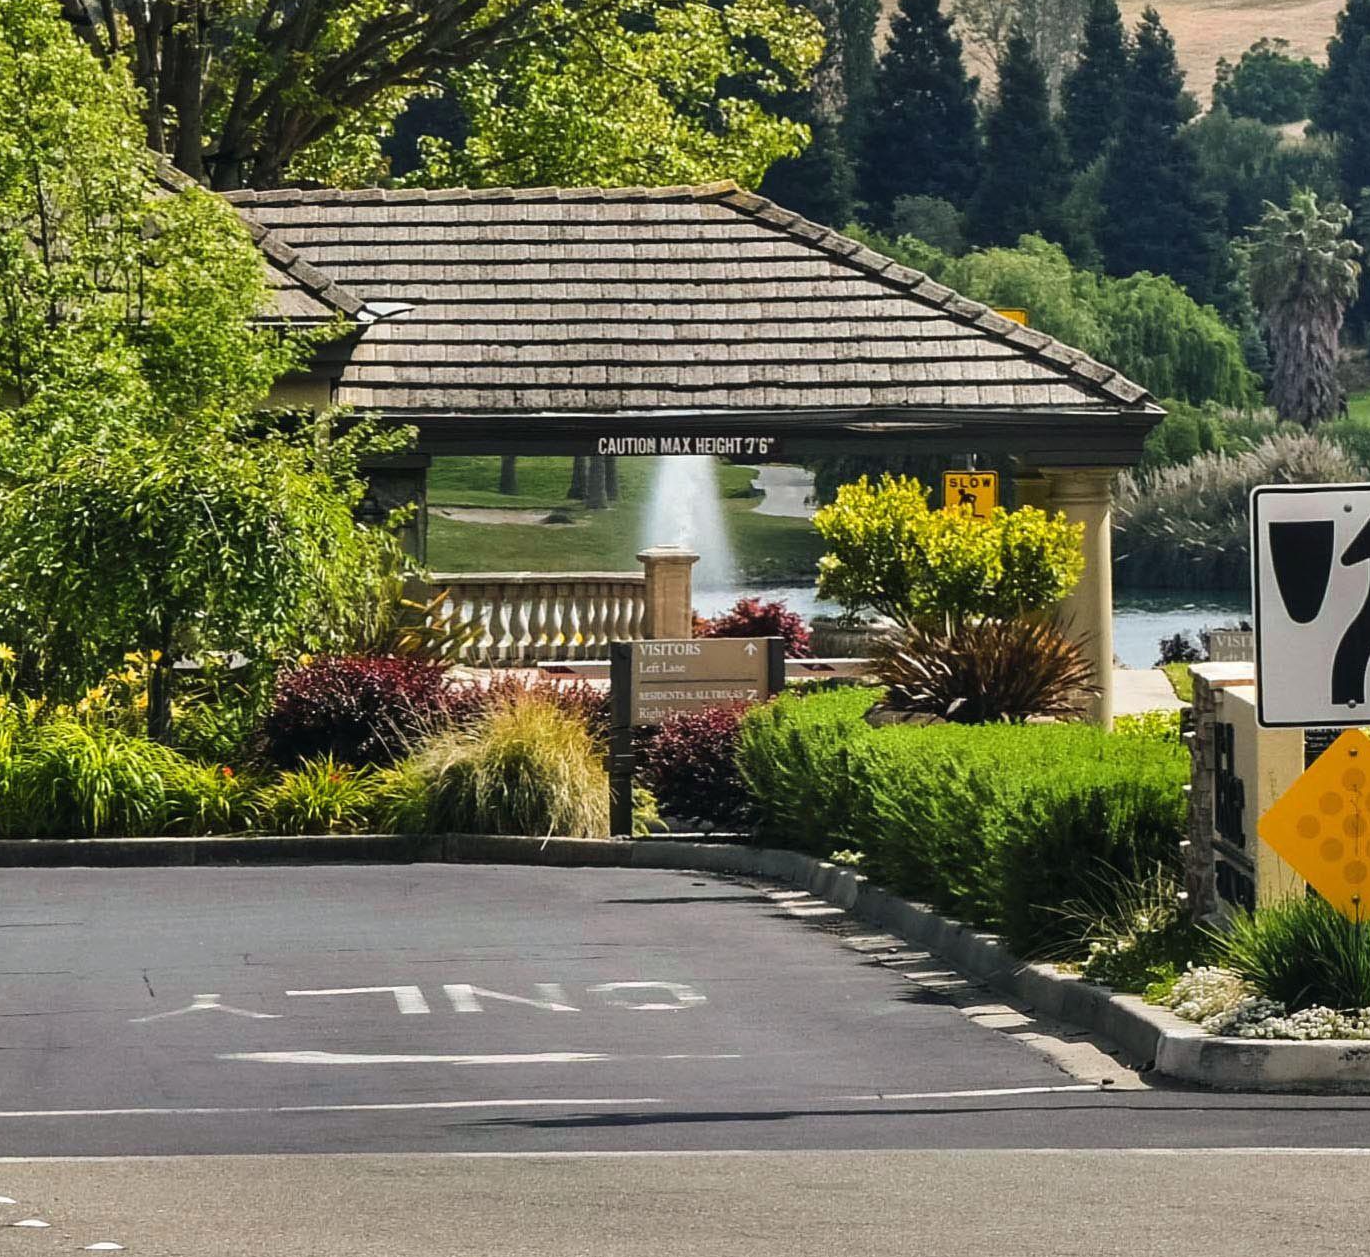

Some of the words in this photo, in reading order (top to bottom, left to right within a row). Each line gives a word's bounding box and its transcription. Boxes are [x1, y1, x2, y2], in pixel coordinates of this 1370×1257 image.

[598, 437, 656, 454] CAUTION
[660, 437, 691, 454] MAX
[695, 437, 743, 454] HEIGHT
[949, 477, 991, 488] SLOW
[639, 643, 701, 656] VISITORS
[639, 661, 662, 674] Left
[663, 661, 686, 673] Lane
